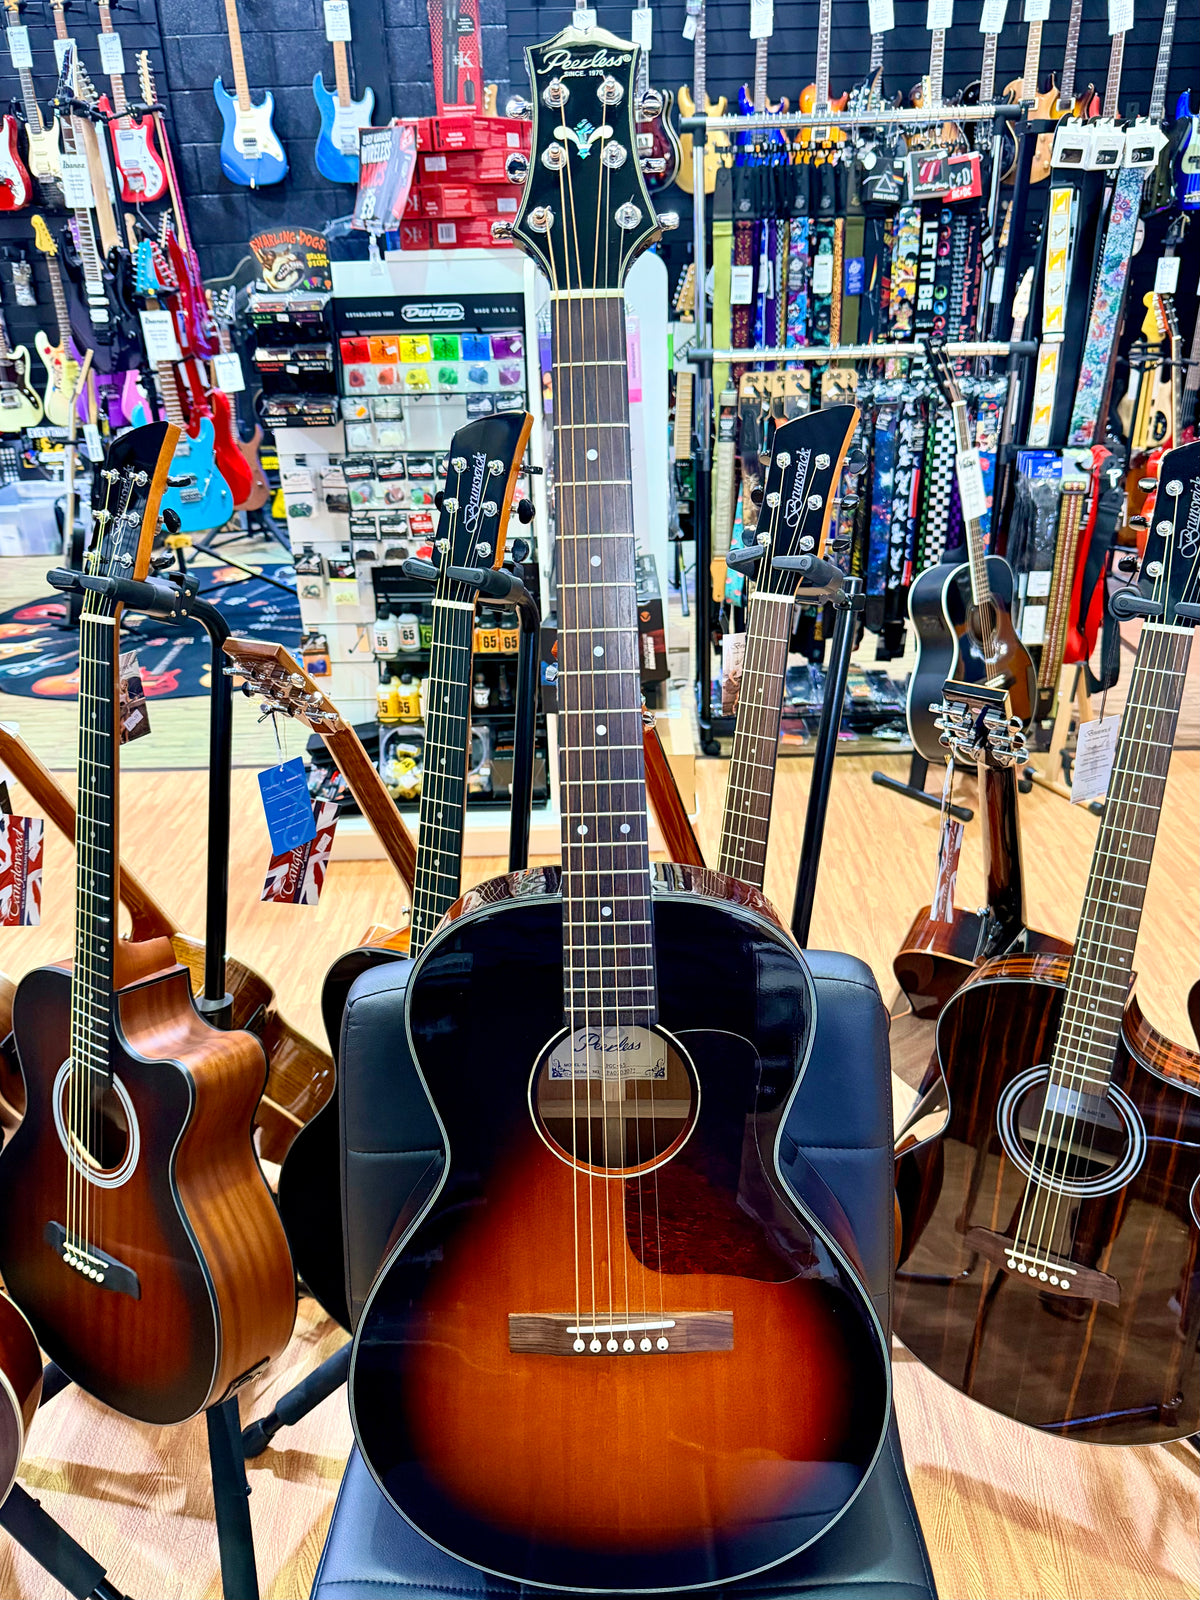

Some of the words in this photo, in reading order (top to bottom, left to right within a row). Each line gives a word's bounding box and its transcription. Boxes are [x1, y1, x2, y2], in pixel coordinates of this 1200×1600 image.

[62, 160, 86, 169] Ibanez
[249, 231, 296, 253] SNARLING
[921, 221, 939, 259] LET
[919, 261, 936, 283] IT
[916, 284, 934, 311] BE
[404, 306, 462, 319] Dunlop
[463, 452, 487, 534] Brunswick
[783, 447, 812, 528] Brunswick
[377, 636, 388, 647] 65
[402, 629, 415, 640] 65
[424, 631, 432, 643] 6
[483, 636, 497, 649] 65
[504, 636, 518, 649] 65
[8, 828, 24, 922] Tanglewood
[280, 845, 305, 898] Tangle
[574, 1032, 642, 1053] Peerless
